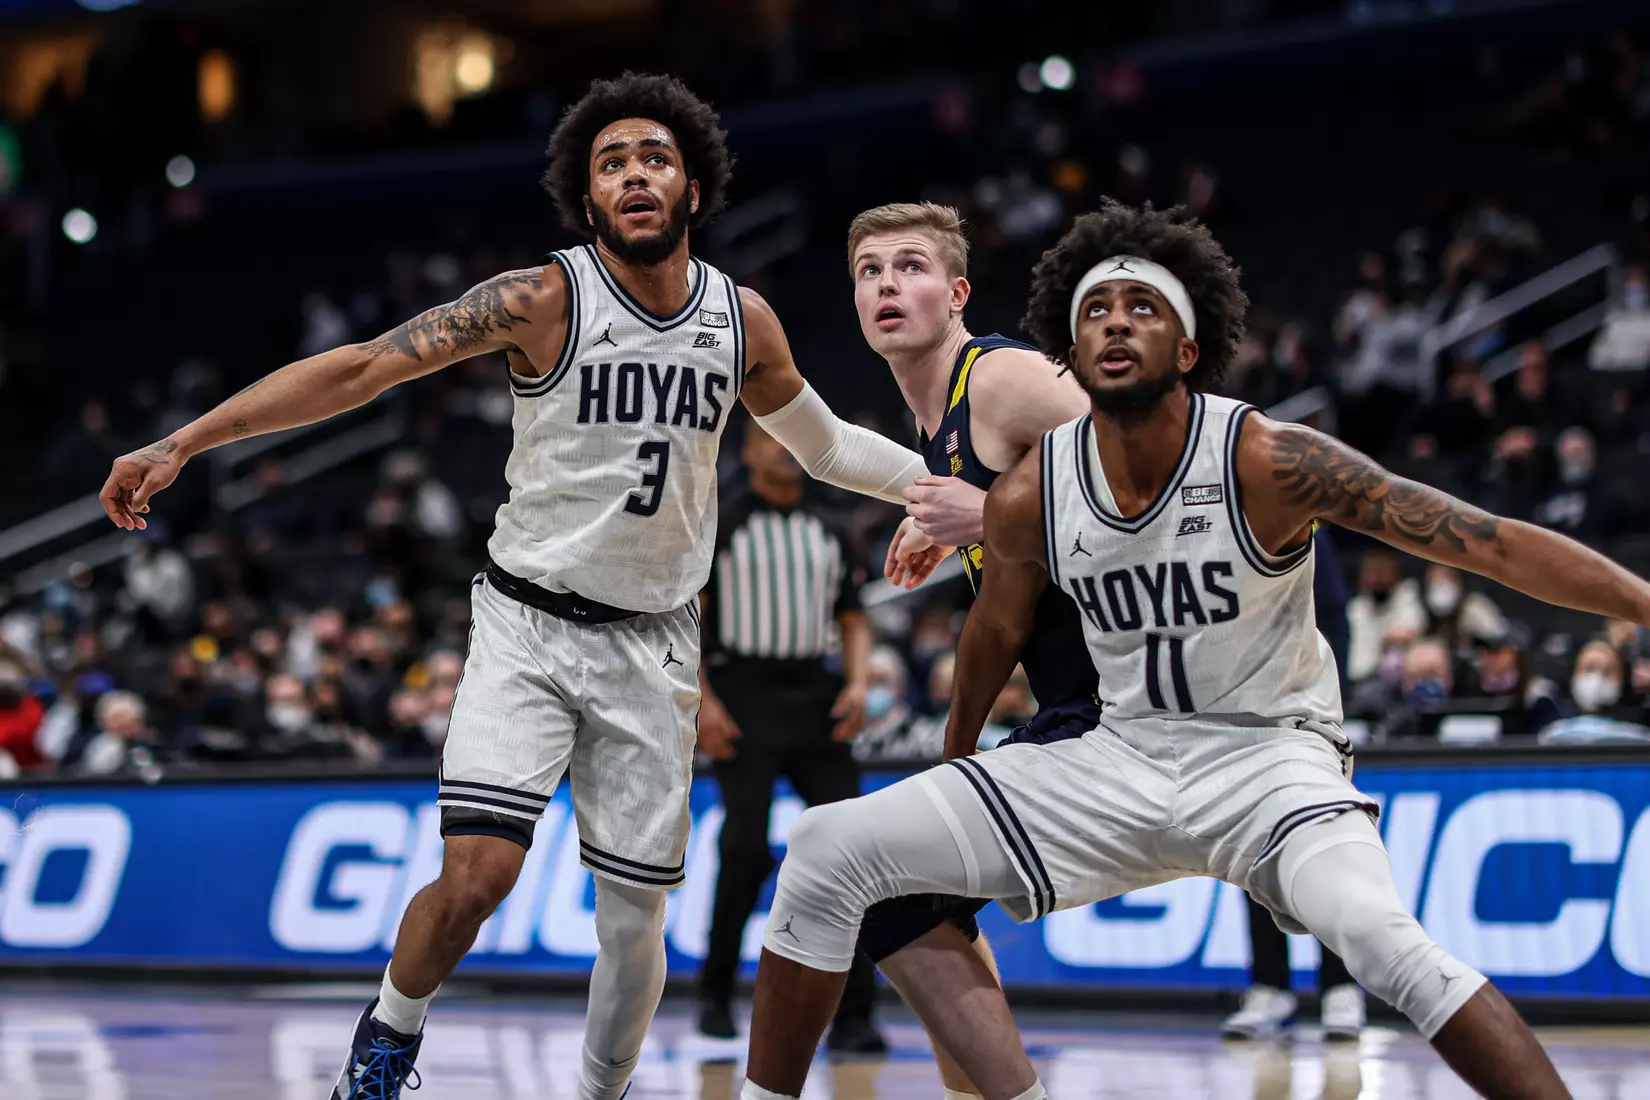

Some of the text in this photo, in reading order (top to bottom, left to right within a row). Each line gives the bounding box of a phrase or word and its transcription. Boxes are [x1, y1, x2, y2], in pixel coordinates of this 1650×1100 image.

[698, 332, 716, 340] BIG
[694, 339, 721, 347] EAST
[577, 363, 728, 432] HOYAS
[624, 441, 670, 517] 3
[1184, 494, 1221, 503] CHANGE
[1182, 516, 1206, 525] BIG
[1179, 522, 1213, 532] EAST
[1070, 561, 1239, 633] HOYAS
[1146, 633, 1196, 713] 11
